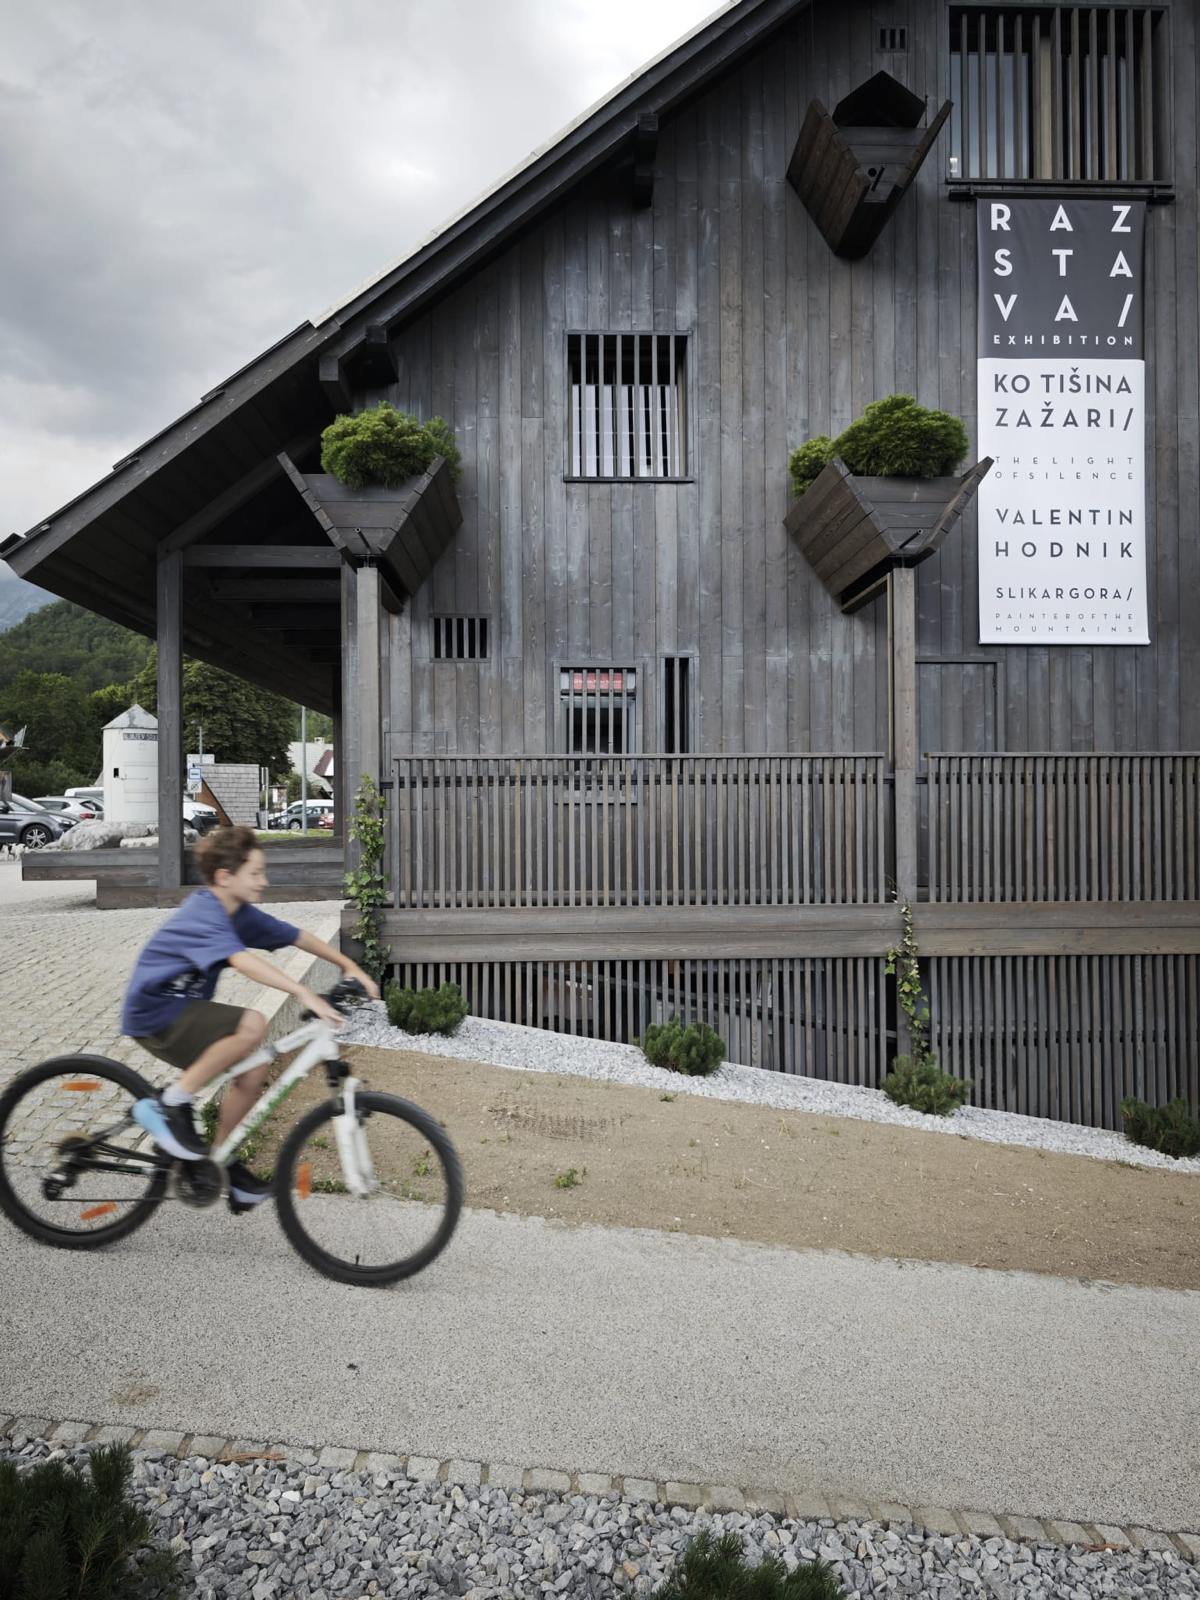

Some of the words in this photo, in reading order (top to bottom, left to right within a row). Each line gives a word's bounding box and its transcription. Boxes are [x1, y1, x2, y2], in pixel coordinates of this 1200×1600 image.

[990, 203, 1132, 233] RAZ
[993, 248, 1134, 278] STA
[993, 293, 1134, 328] VA/
[993, 334, 1133, 346] EXHIBITION
[994, 373, 1031, 394] KO
[1040, 366, 1133, 394] TIŠINA
[995, 400, 1134, 432] ZAŽARI/
[995, 508, 1133, 526] VALENTIN
[995, 541, 1133, 559] HODNIK
[995, 625, 1133, 634] MOUNTAINS
